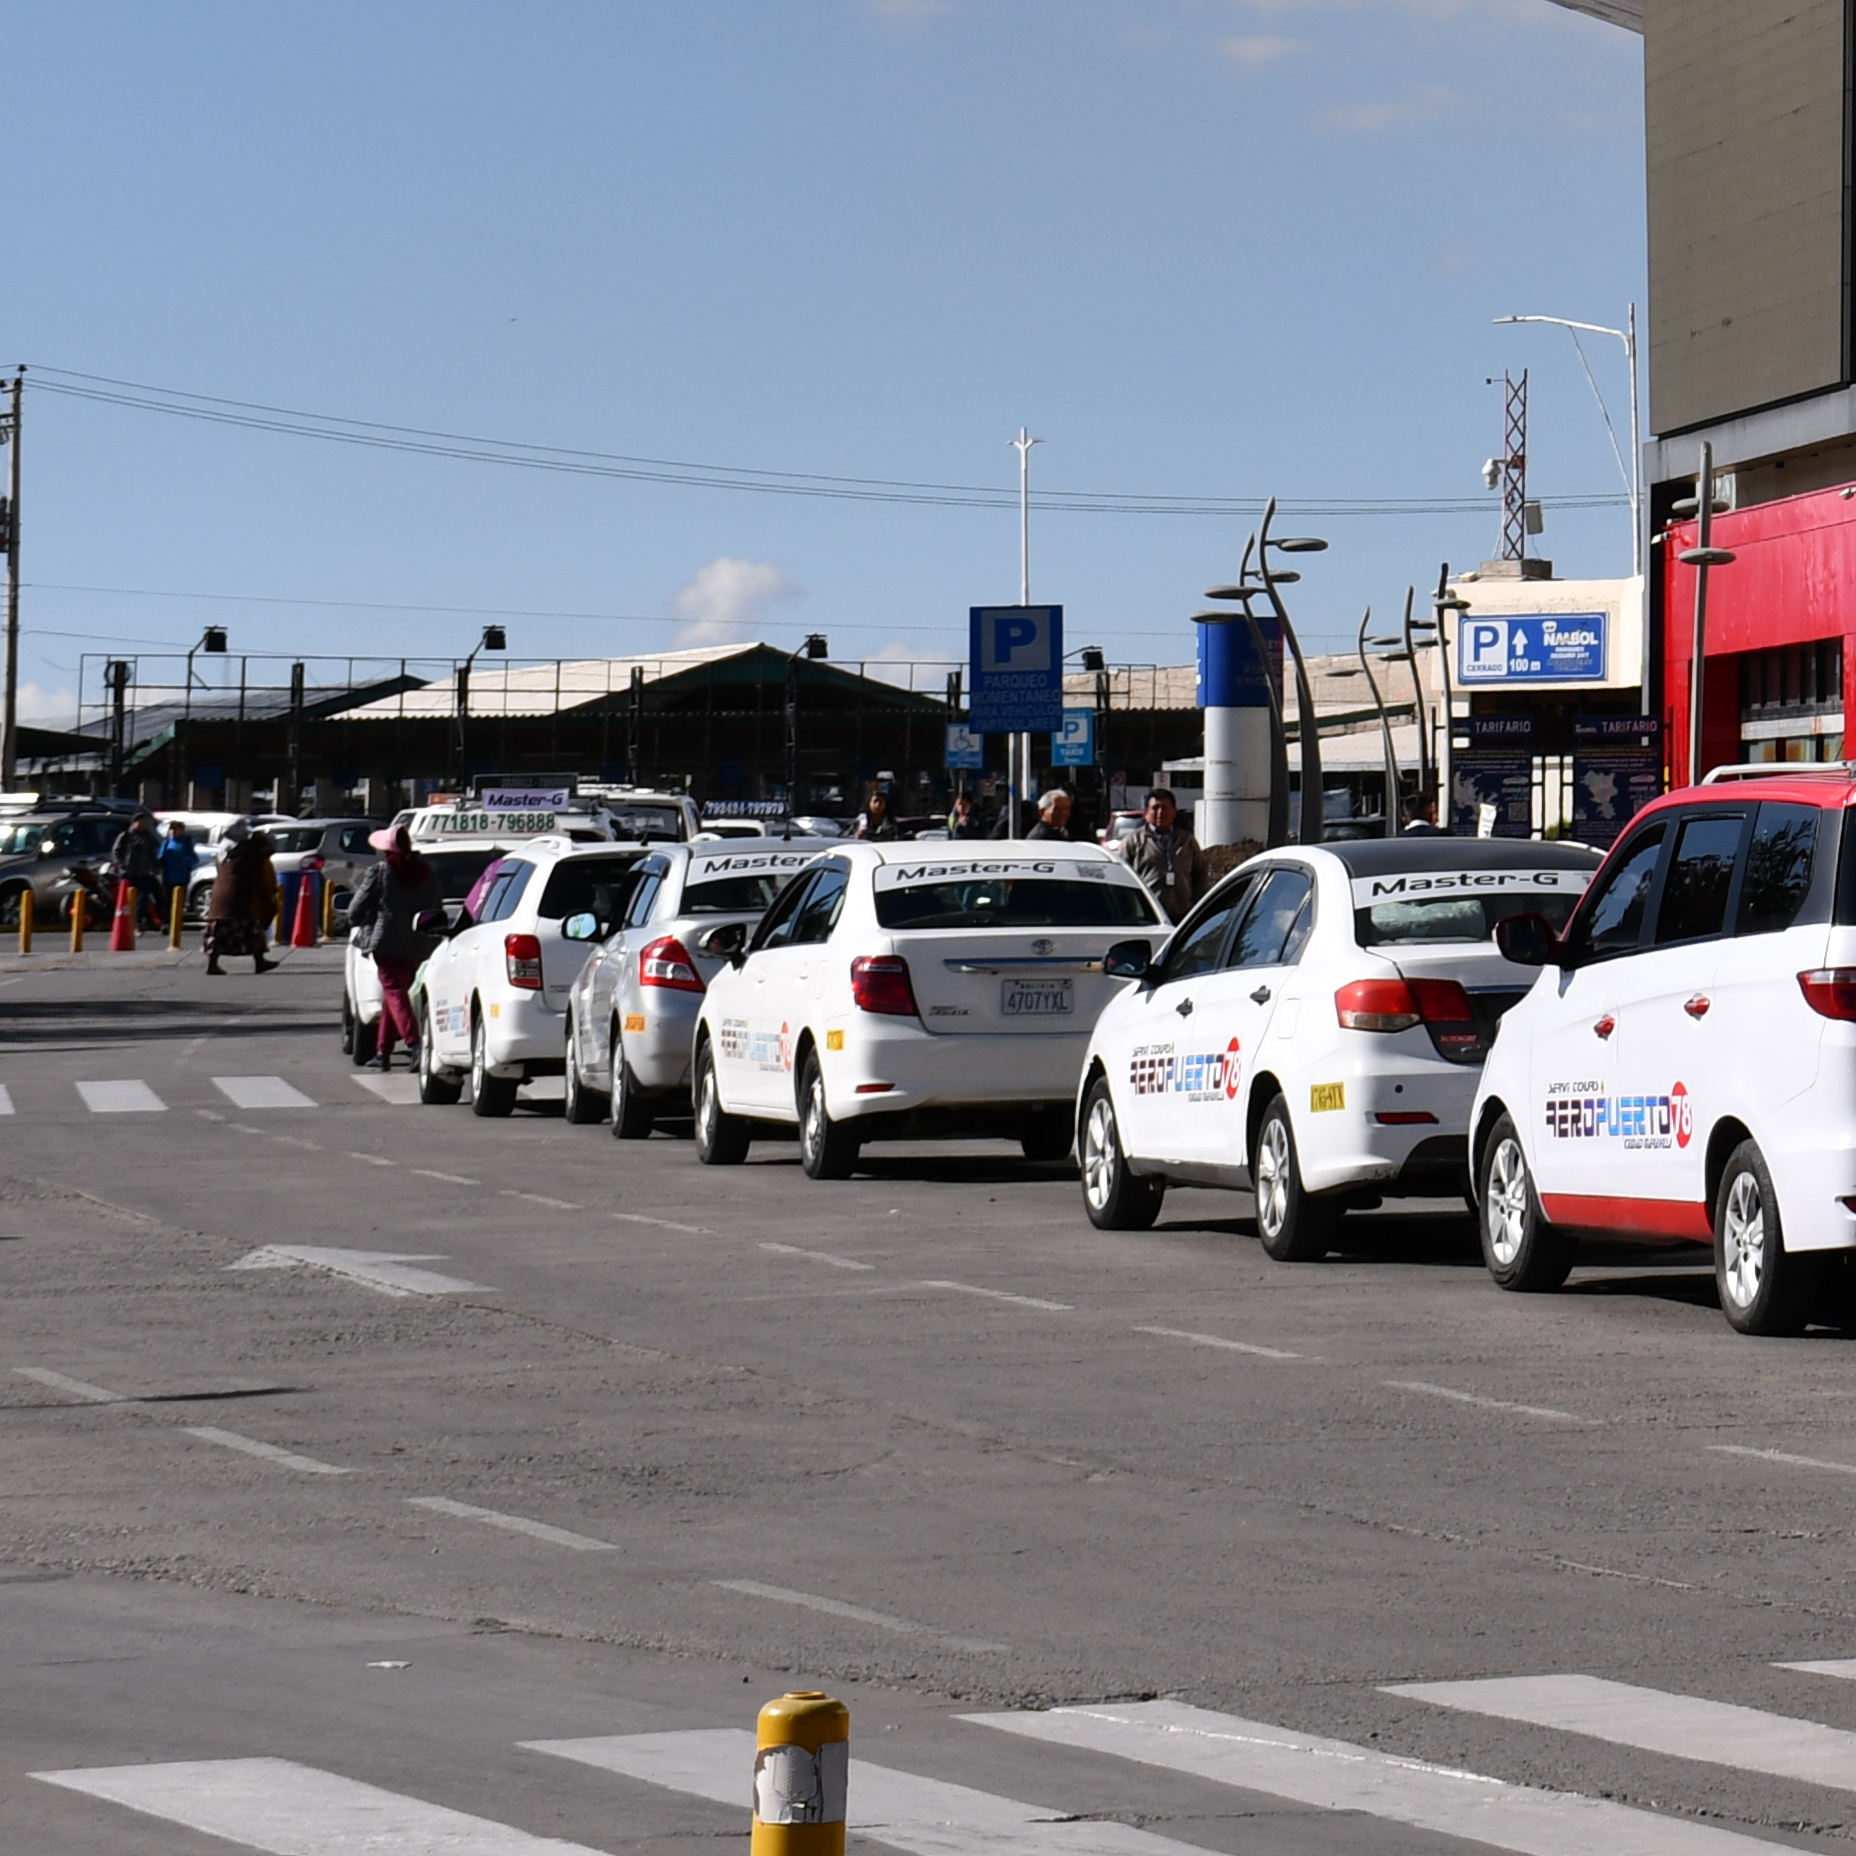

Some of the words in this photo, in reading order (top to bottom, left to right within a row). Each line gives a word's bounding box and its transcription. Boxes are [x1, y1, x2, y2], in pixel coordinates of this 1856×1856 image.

[994, 617, 1038, 664] P
[1473, 625, 1500, 662] P
[1509, 658, 1528, 672] 100
[1531, 661, 1541, 671] m
[984, 673, 1048, 688] PARQUEO
[1064, 721, 1080, 741] P
[1475, 720, 1532, 734] TARIFARIO
[1602, 720, 1658, 734] TARIFARIO
[487, 792, 564, 806] Master-G
[431, 812, 556, 831] 771818-796888
[703, 853, 811, 874] Master
[896, 861, 1056, 882] Master-G
[1371, 872, 1560, 897] Master-G
[1006, 991, 1069, 1012] 4707YXL
[1130, 1053, 1225, 1095] AEROPUERTO
[1224, 1051, 1242, 1088] 78
[1545, 1095, 1671, 1138] AEROPUERTO
[1672, 1094, 1693, 1136] 78
